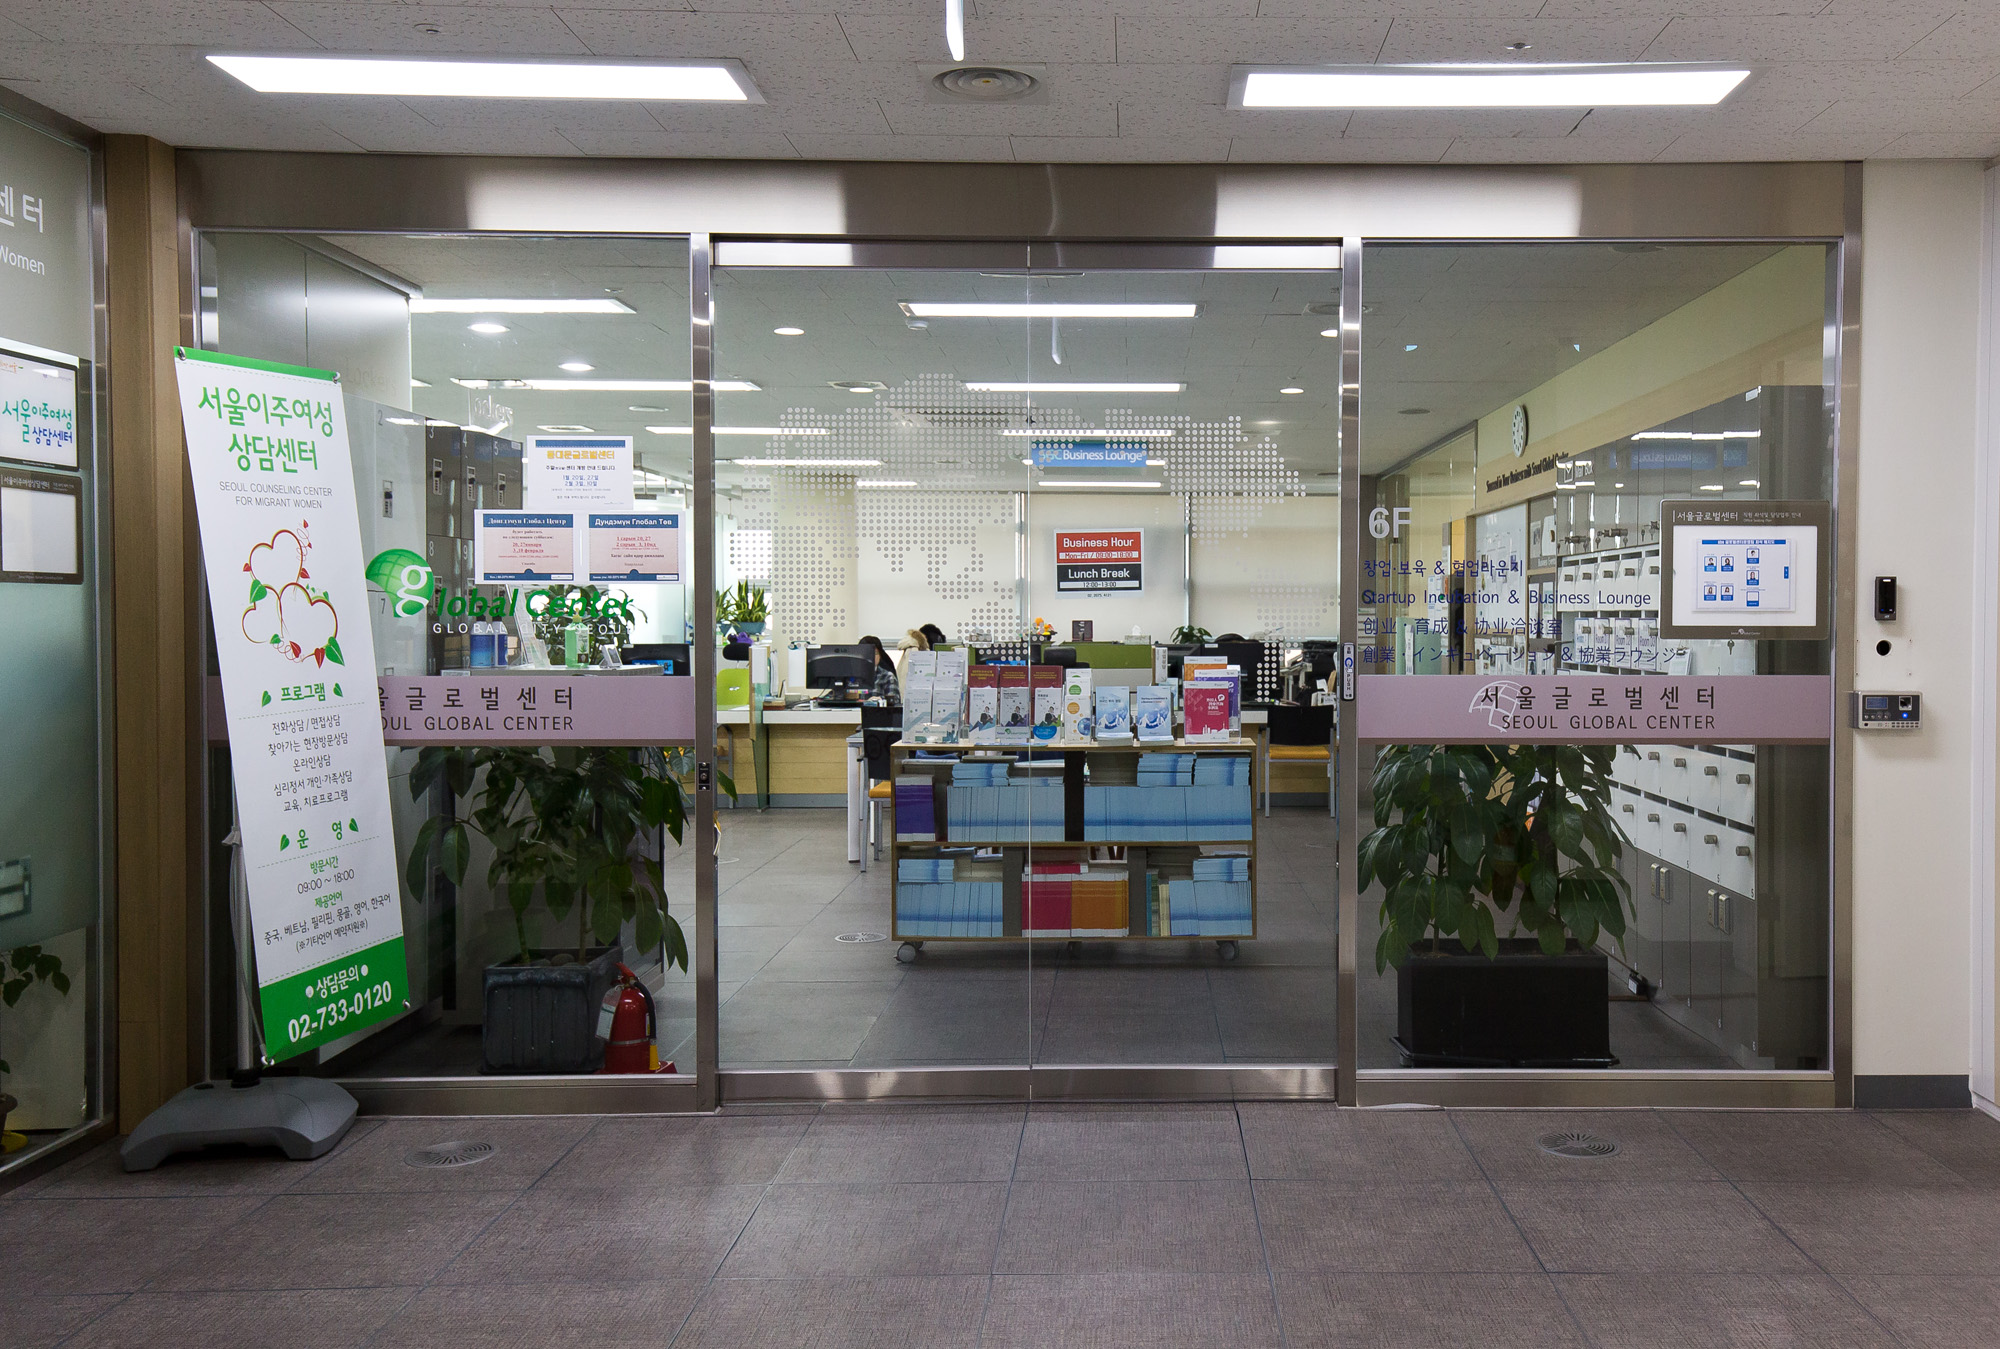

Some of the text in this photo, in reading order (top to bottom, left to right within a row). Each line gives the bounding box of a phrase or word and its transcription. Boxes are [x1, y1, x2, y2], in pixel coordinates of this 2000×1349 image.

[2, 399, 72, 443] 서울이주여성
[198, 386, 333, 437] 서울이주여성
[377, 409, 383, 426] 2
[33, 427, 72, 447] 상담센터
[428, 423, 435, 439] 3
[462, 432, 468, 448] 4
[228, 433, 318, 473] 상담센터
[493, 441, 499, 456] 5
[547, 450, 615, 460] 동대문글로벌센터
[1063, 449, 1104, 461] Business
[1105, 450, 1143, 463] Lounge
[219, 481, 333, 497] SEOUL COUNSELING CENTER
[235, 496, 323, 509] FOR MIGRANT WOMEN
[1368, 507, 1413, 539] 6F
[1677, 511, 1739, 522] 서울글로벌센터
[428, 541, 435, 557] 8
[1063, 537, 1134, 548] Business Hour
[463, 545, 468, 560] 9
[1068, 568, 1130, 579] Lunch Break
[1364, 560, 1427, 577] 창업·보육
[1434, 560, 1446, 575] &
[1452, 559, 1523, 578] 협업라운지
[380, 598, 387, 615] 7
[525, 589, 635, 618] Center
[1362, 589, 1651, 607] Startup Incubation & Business Lounge
[1456, 619, 1468, 634] &
[1474, 616, 1563, 635] 协业洽谈室
[1561, 647, 1573, 661] &
[1579, 646, 1677, 664] 協業ラウンジ
[281, 683, 326, 702] 프로그램
[1481, 686, 1715, 711] 서울글로벌센터
[272, 719, 304, 736] 전화상담
[310, 714, 341, 730] 면접상담
[424, 716, 494, 731] GLOBAL
[503, 716, 574, 731] CENTER
[1502, 715, 1715, 729] SEOUL GLOBAL CENTER
[268, 731, 348, 757] 찾아가는 현장방문상담
[293, 753, 331, 773] 온라인상담
[273, 769, 353, 797] 심리정서 개인·가족상담
[283, 789, 349, 812] 교육, 치료프로그램
[310, 855, 339, 874] 방문시간
[297, 878, 322, 894] 09:00
[333, 868, 355, 884] 18:00
[314, 890, 343, 909] 제공언어
[264, 893, 392, 945] 중국, 베트남, 필리핀, 몽골, 영어, 한국어
[316, 964, 360, 999] 상담문의
[288, 980, 392, 1043] 02-733-0120
